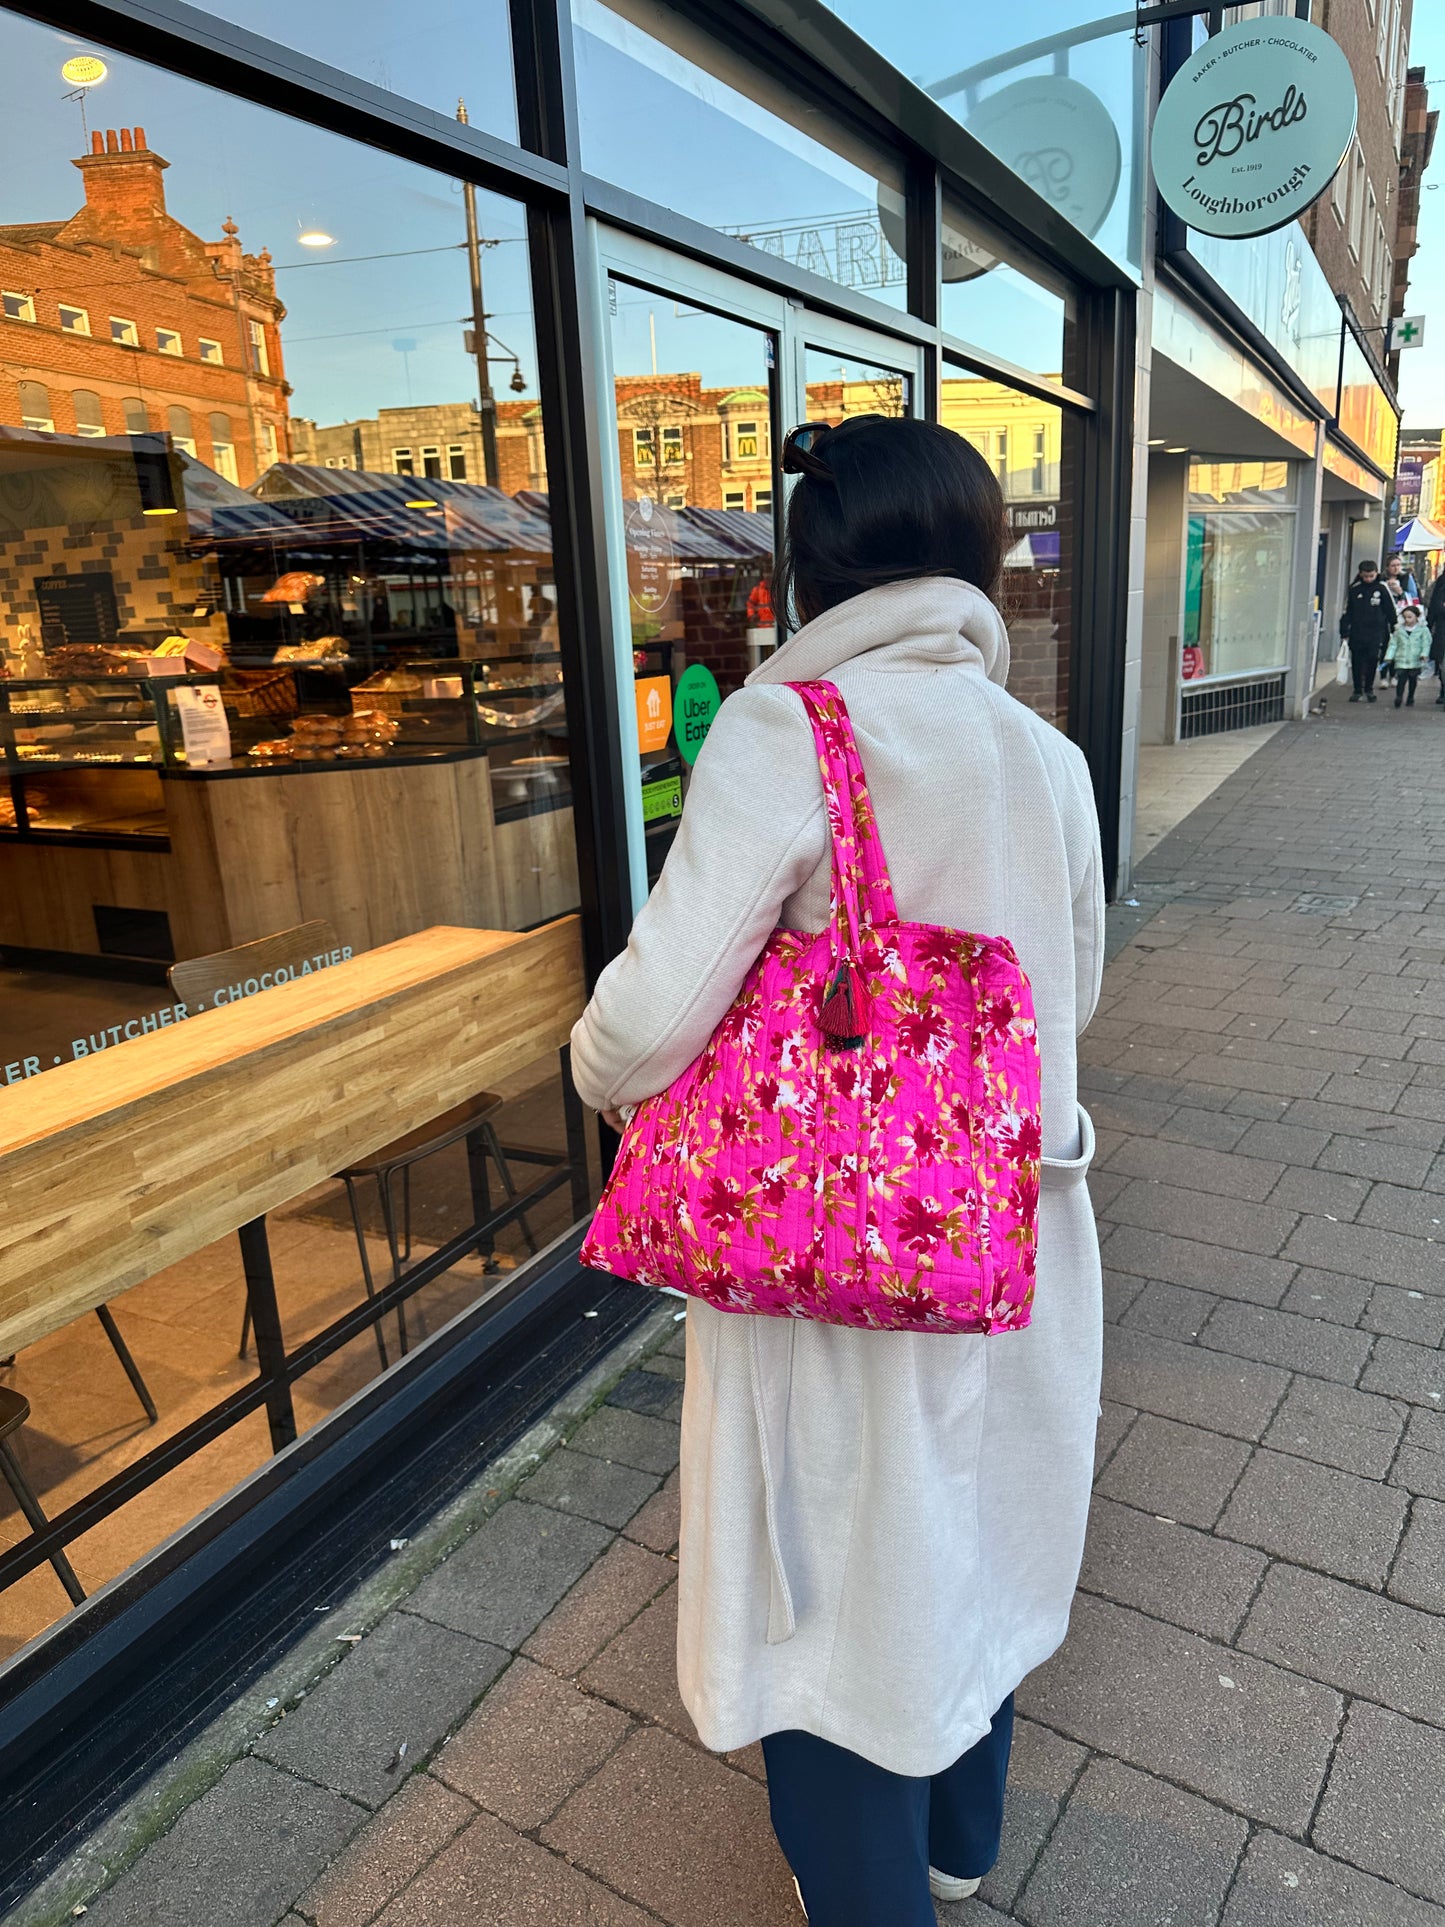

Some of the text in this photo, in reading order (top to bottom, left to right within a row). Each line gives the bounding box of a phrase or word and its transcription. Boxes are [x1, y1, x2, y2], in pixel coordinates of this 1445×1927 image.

[1192, 37, 1318, 83] BAKER BUTCHER CHOCOLATIER
[1193, 84, 1308, 166] Birds
[1231, 163, 1263, 174] Est. 1919
[1181, 161, 1312, 216] Loughborough
[683, 698, 711, 718] Uber
[685, 721, 711, 742] Eats
[673, 795, 679, 807] 5
[0, 946, 354, 1088] ER BUTCHER CHOCOLATIER
